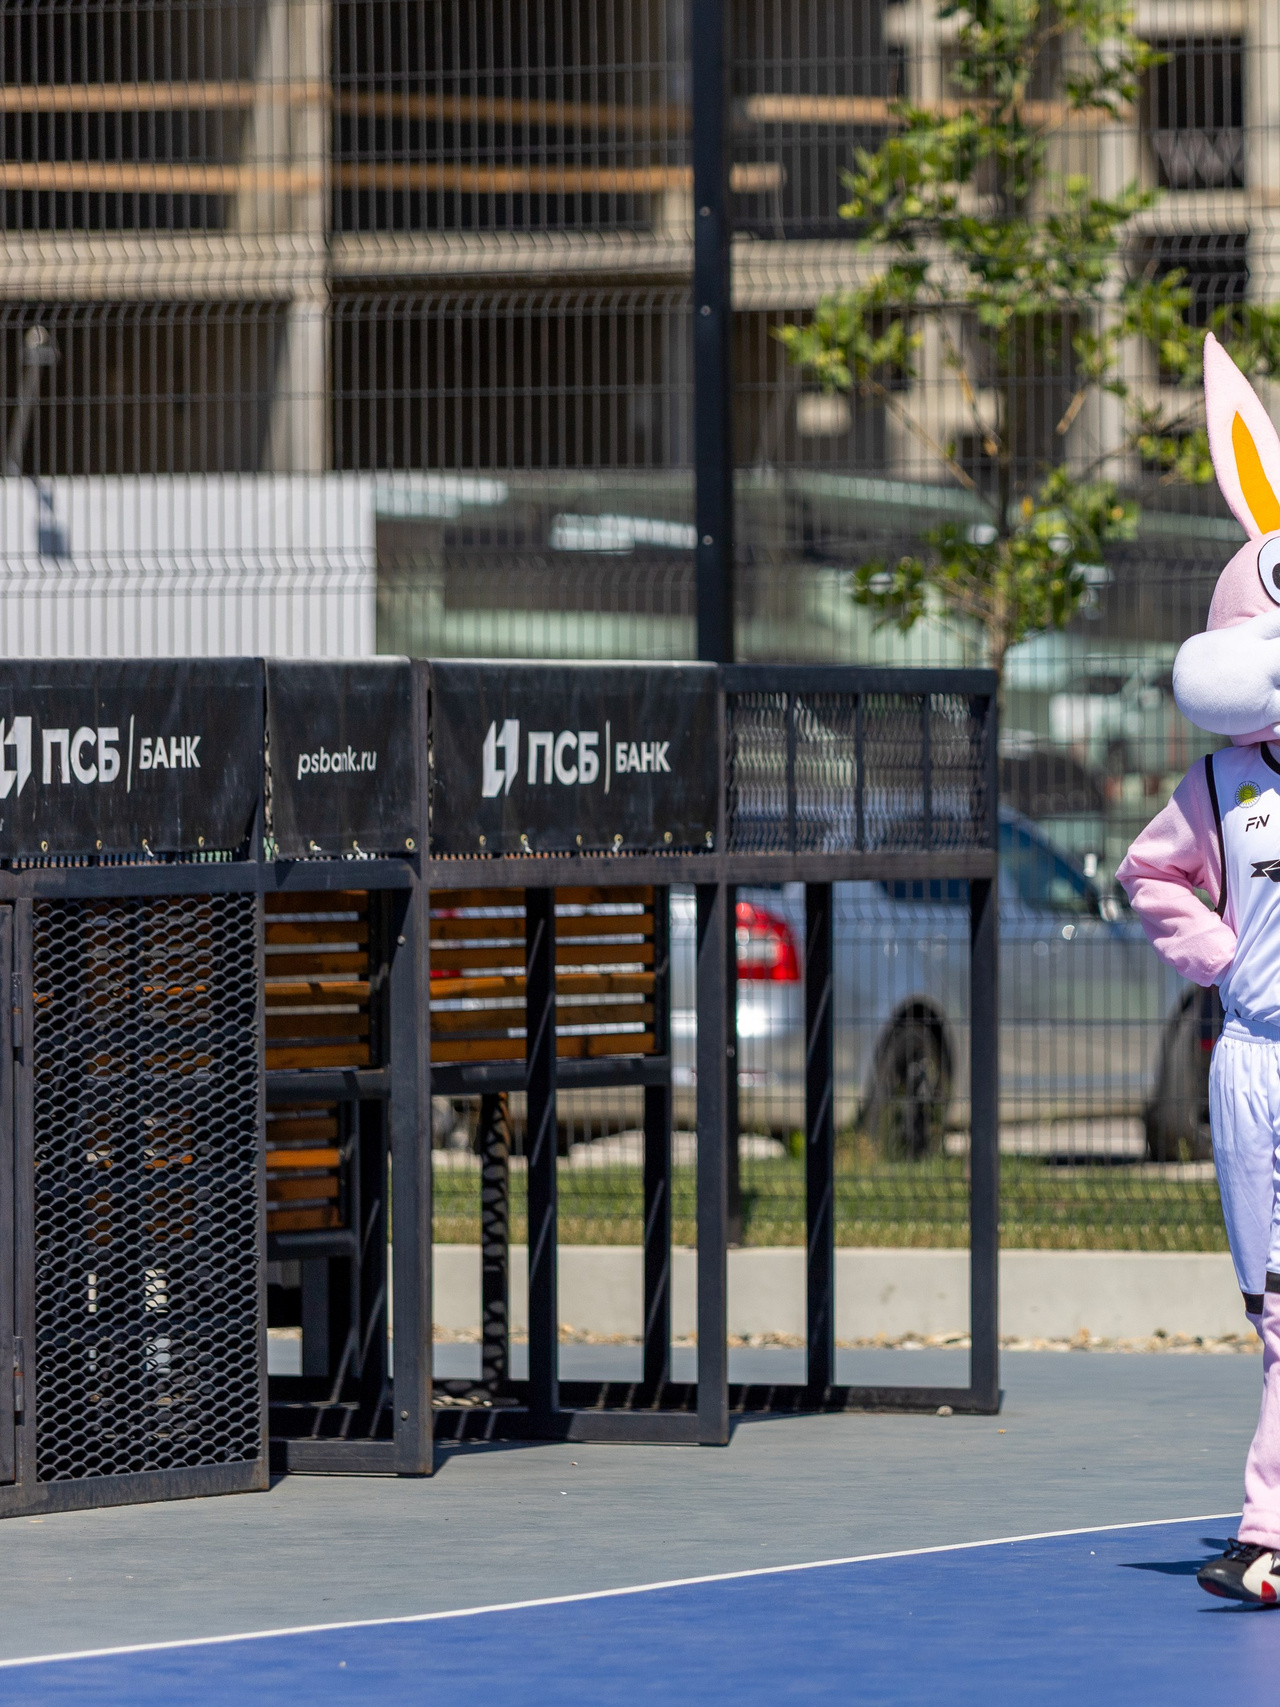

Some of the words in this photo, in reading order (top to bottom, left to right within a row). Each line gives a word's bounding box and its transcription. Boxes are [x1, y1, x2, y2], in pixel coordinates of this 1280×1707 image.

[42, 726, 121, 785] ПСБ
[139, 735, 202, 770] БАНК
[297, 744, 378, 781] psbank.ru
[527, 730, 600, 786] ПСБ
[615, 741, 672, 773] БАНК
